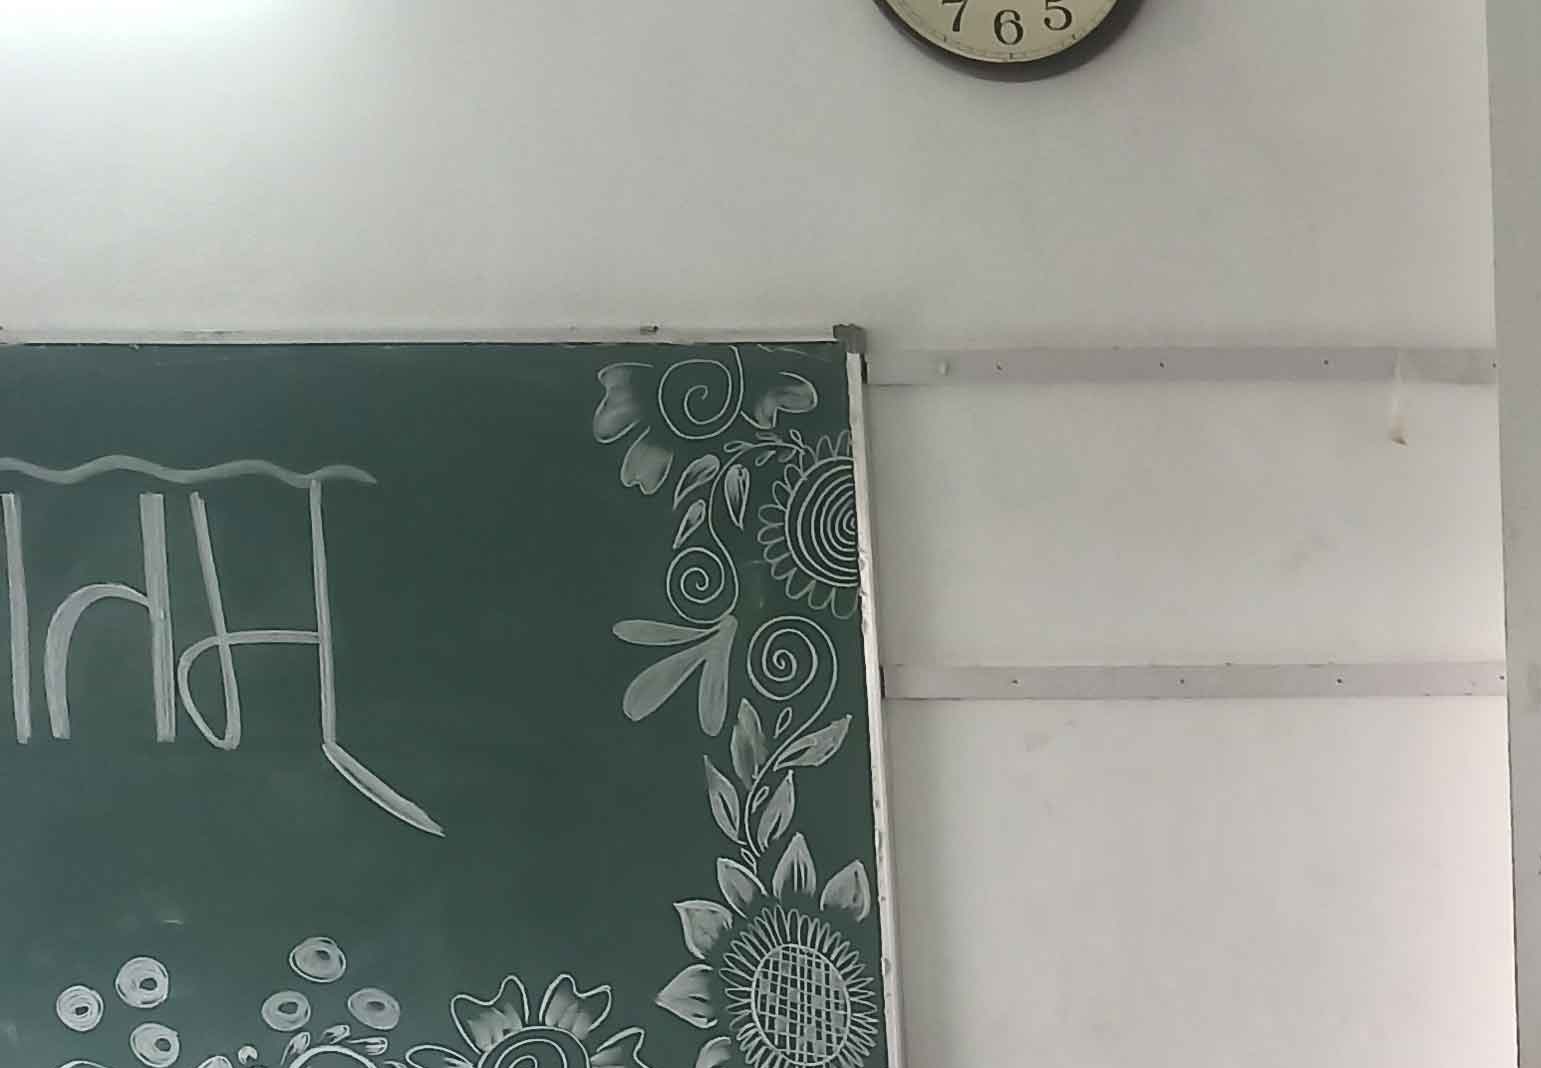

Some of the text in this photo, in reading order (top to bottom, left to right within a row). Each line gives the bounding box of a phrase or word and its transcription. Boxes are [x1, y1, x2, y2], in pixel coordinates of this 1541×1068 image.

[942, 0, 968, 32] 7
[993, 9, 1024, 45] 6
[1044, 0, 1073, 31] 5
